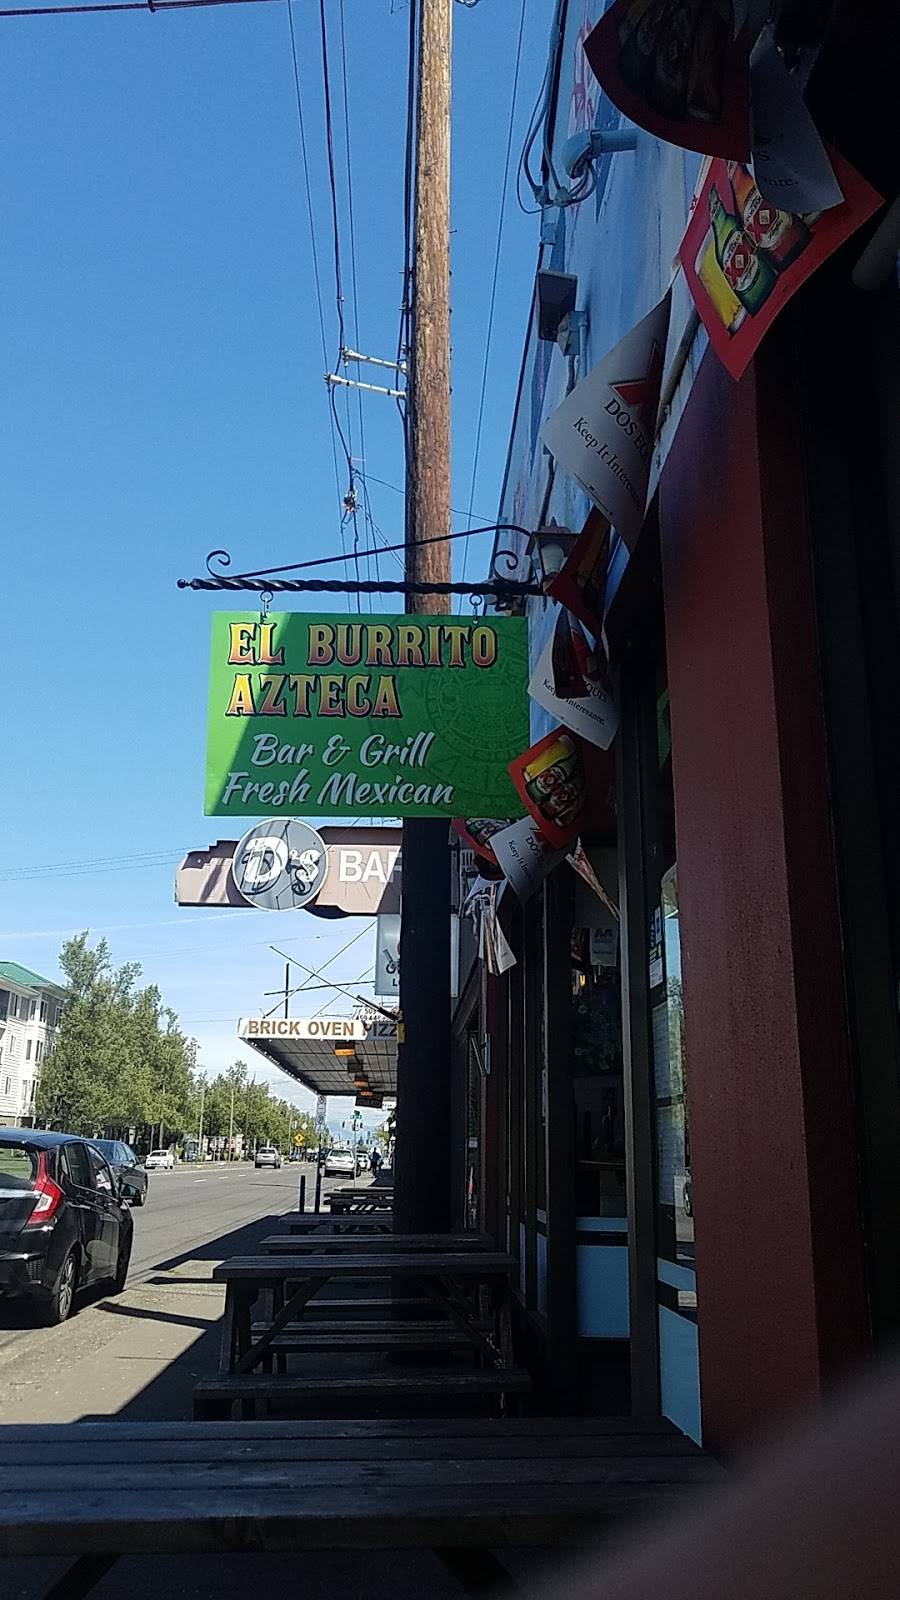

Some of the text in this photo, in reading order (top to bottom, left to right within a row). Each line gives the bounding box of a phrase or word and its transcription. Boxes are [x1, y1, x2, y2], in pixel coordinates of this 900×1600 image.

[604, 398, 638, 436] DOS
[573, 417, 598, 449] Keep
[597, 443, 609, 461] It
[227, 622, 498, 668] EL BURRITO
[225, 673, 403, 719] AZTECA
[250, 731, 437, 768] Bar & Grill
[221, 768, 453, 808] Fresh Mexican
[508, 839, 520, 859] Keep
[525, 836, 540, 858] DOS
[248, 1020, 301, 1035] BRICK
[307, 1021, 354, 1036] OVEN
